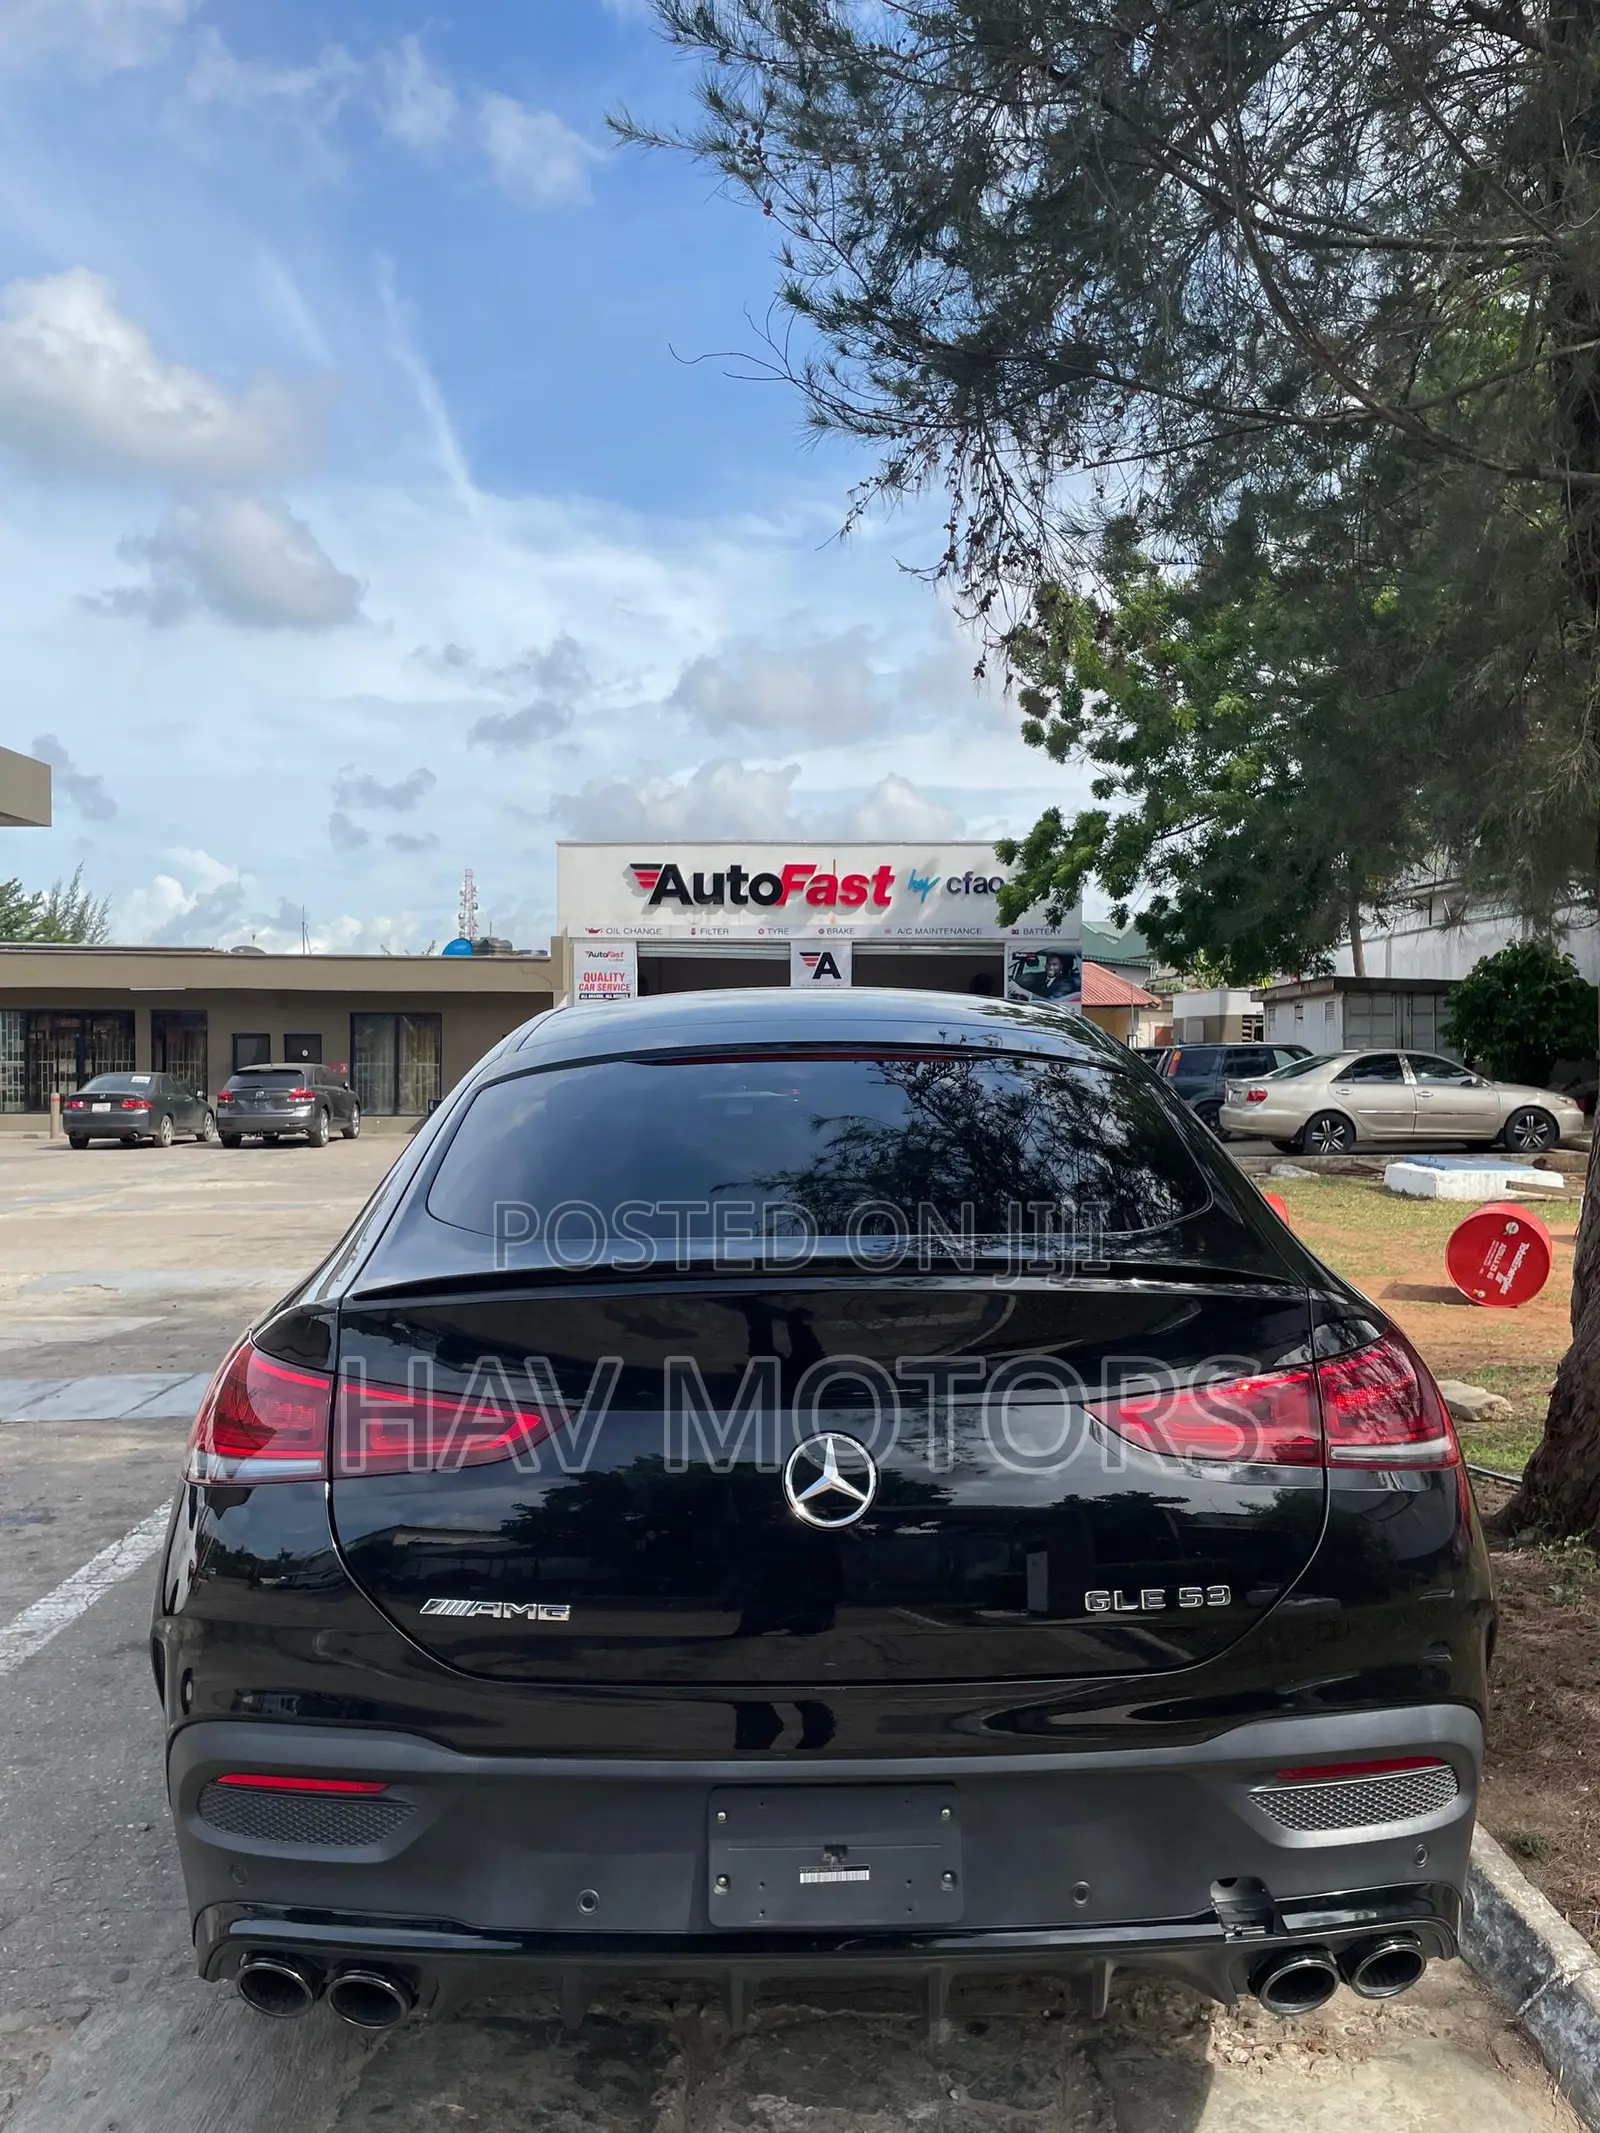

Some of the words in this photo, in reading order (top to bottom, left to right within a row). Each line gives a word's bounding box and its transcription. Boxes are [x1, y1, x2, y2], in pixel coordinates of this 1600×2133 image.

[648, 863, 896, 907] AutoFast
[907, 868, 940, 904] by
[946, 871, 1005, 895] cfao
[605, 927, 622, 936] OIL
[623, 927, 662, 936] CHANGE
[700, 927, 729, 936] FILTER
[767, 927, 790, 936] TYRE
[826, 927, 855, 936] BRAKE
[896, 927, 913, 936] A/C
[914, 927, 982, 936] MAINTENANCE
[1022, 927, 1062, 936] BATTERY
[588, 950, 624, 958] AutoFast
[812, 952, 842, 980] A
[583, 972, 626, 983] QUALITY
[578, 983, 595, 992] CAR
[596, 983, 631, 992] SERVICE
[1084, 1588, 1167, 1612] GLE
[1178, 1584, 1232, 1609] 53
[466, 1600, 572, 1622] AMG
